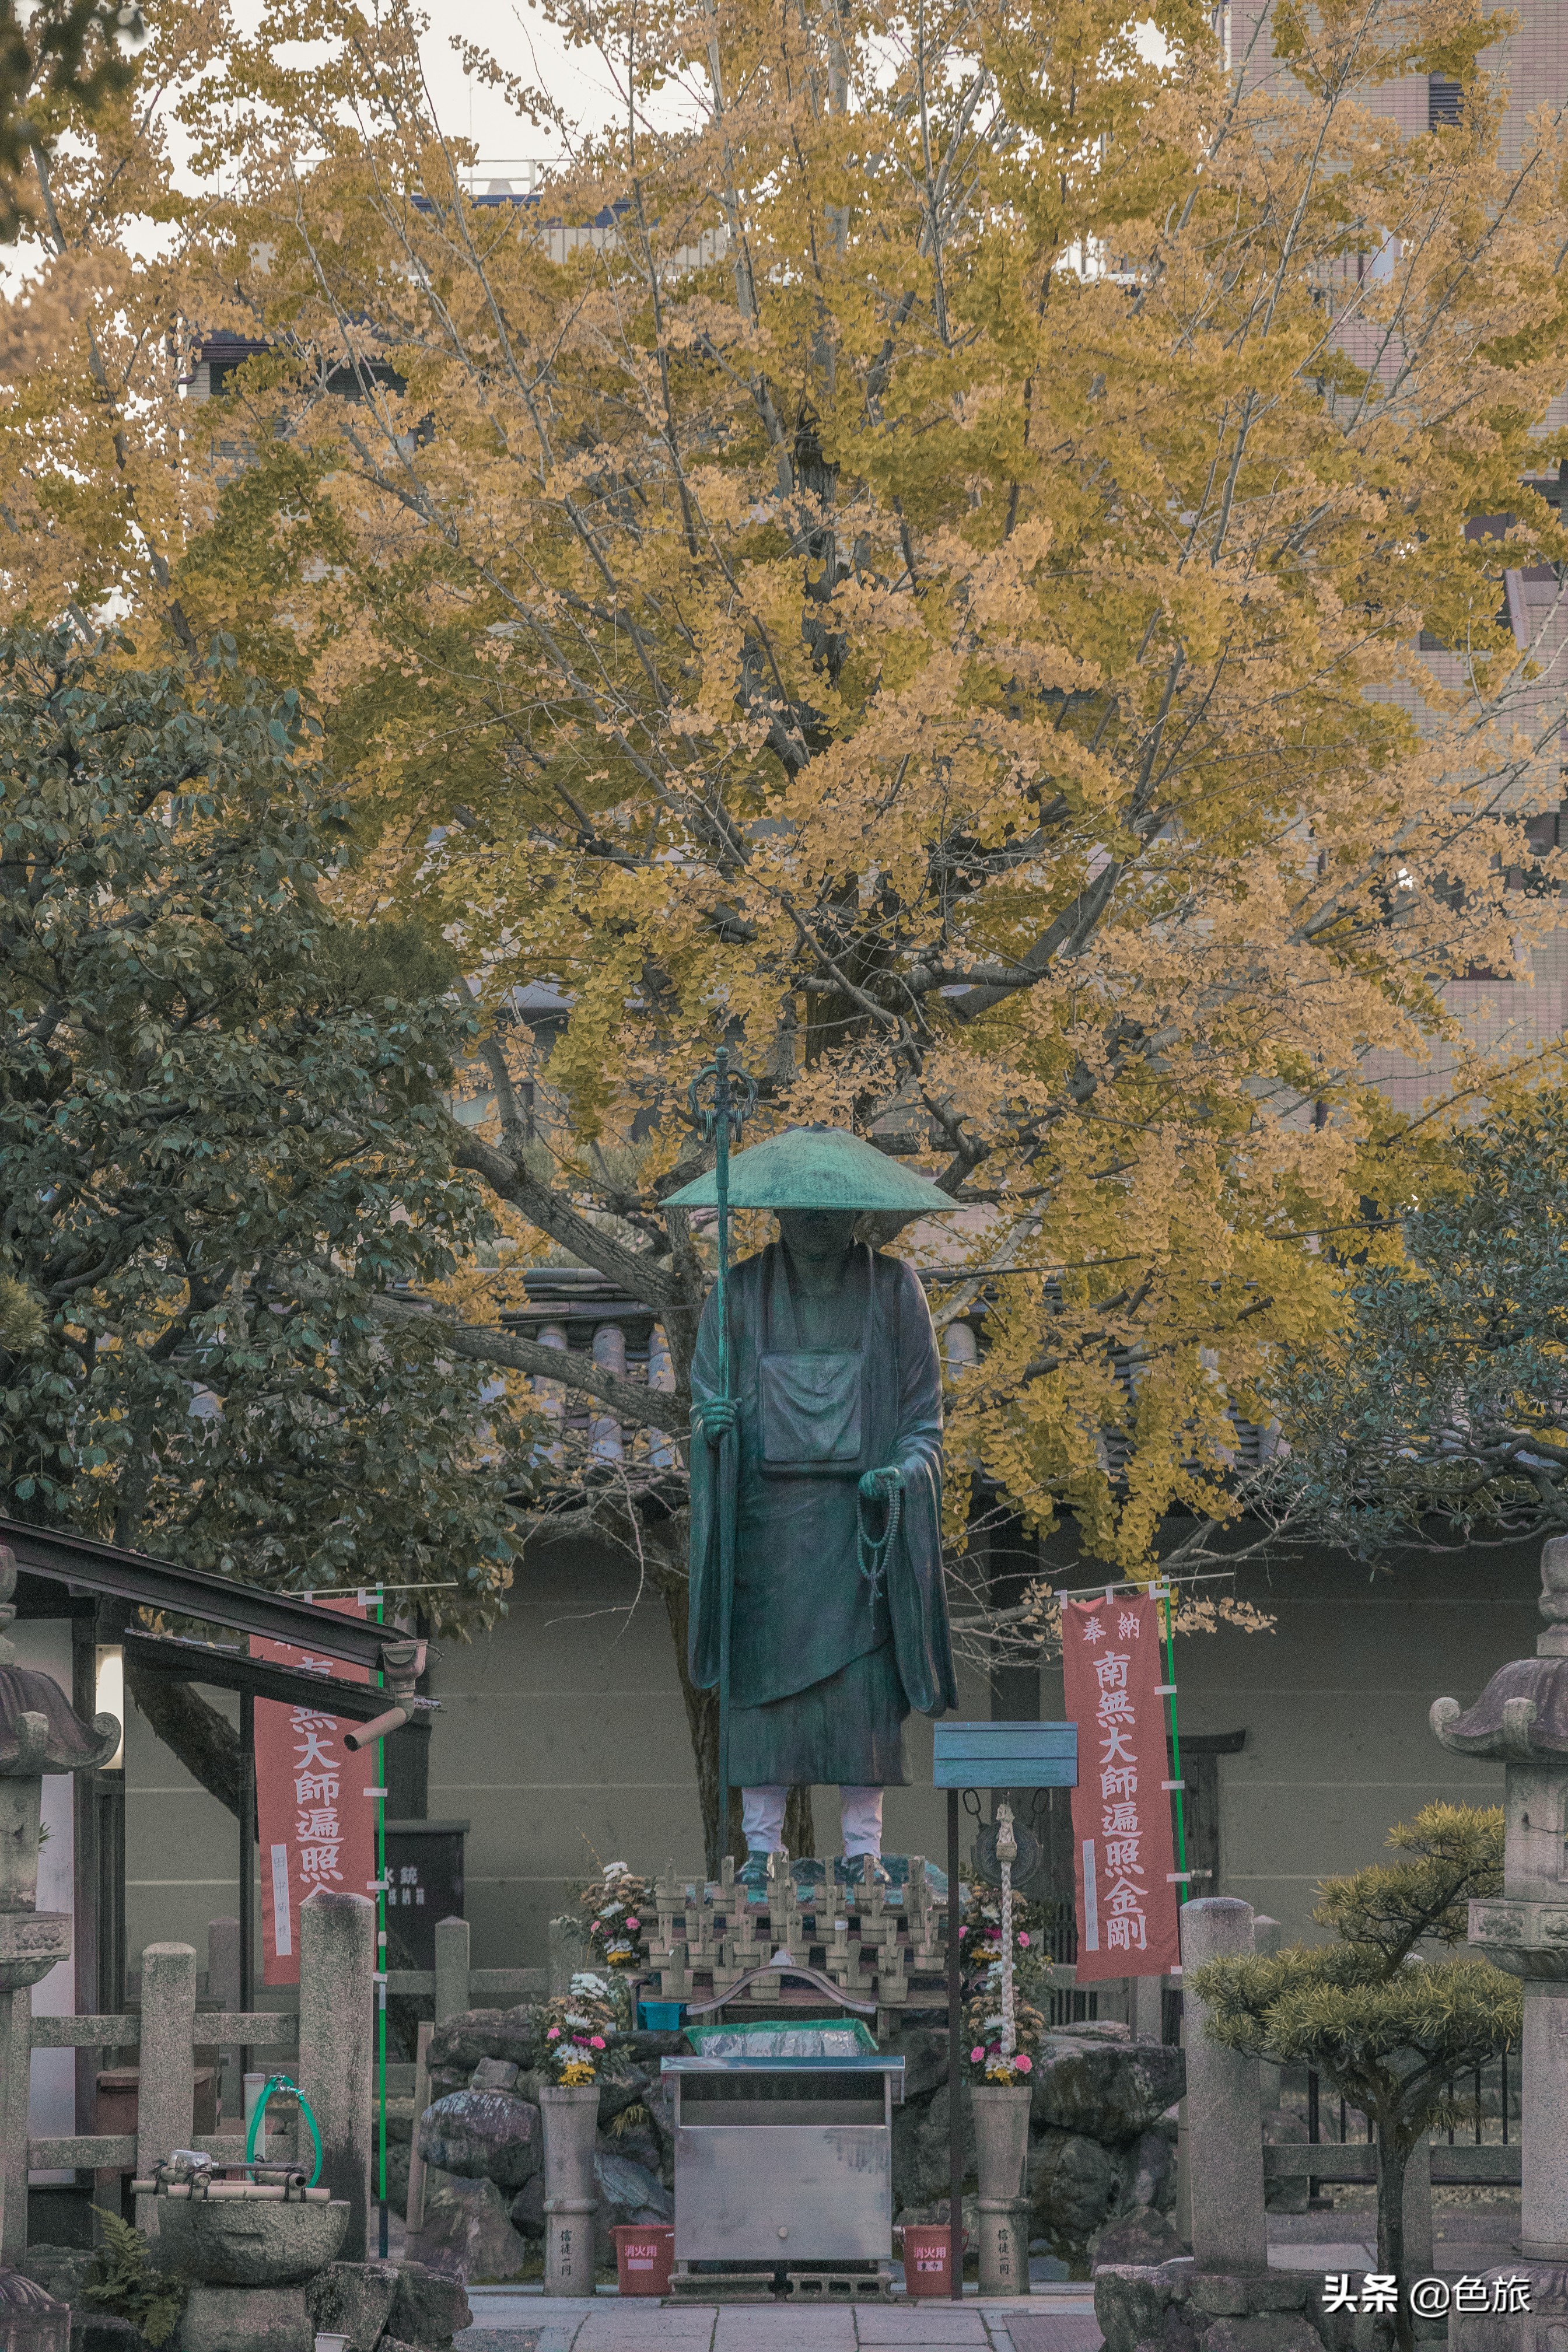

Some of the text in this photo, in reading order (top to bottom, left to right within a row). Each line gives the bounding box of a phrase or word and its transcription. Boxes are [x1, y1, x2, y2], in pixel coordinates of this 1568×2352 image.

[1083, 1612, 1140, 1645] 奉納
[289, 1656, 345, 1906] 無大師遍照
[1093, 1650, 1149, 1951] 南無大師遍照金剛
[561, 2230, 572, 2276] 信徒一同
[625, 2245, 657, 2258] 消火用
[914, 2246, 946, 2259] 消火用
[998, 2228, 1009, 2275] 信徒一同
